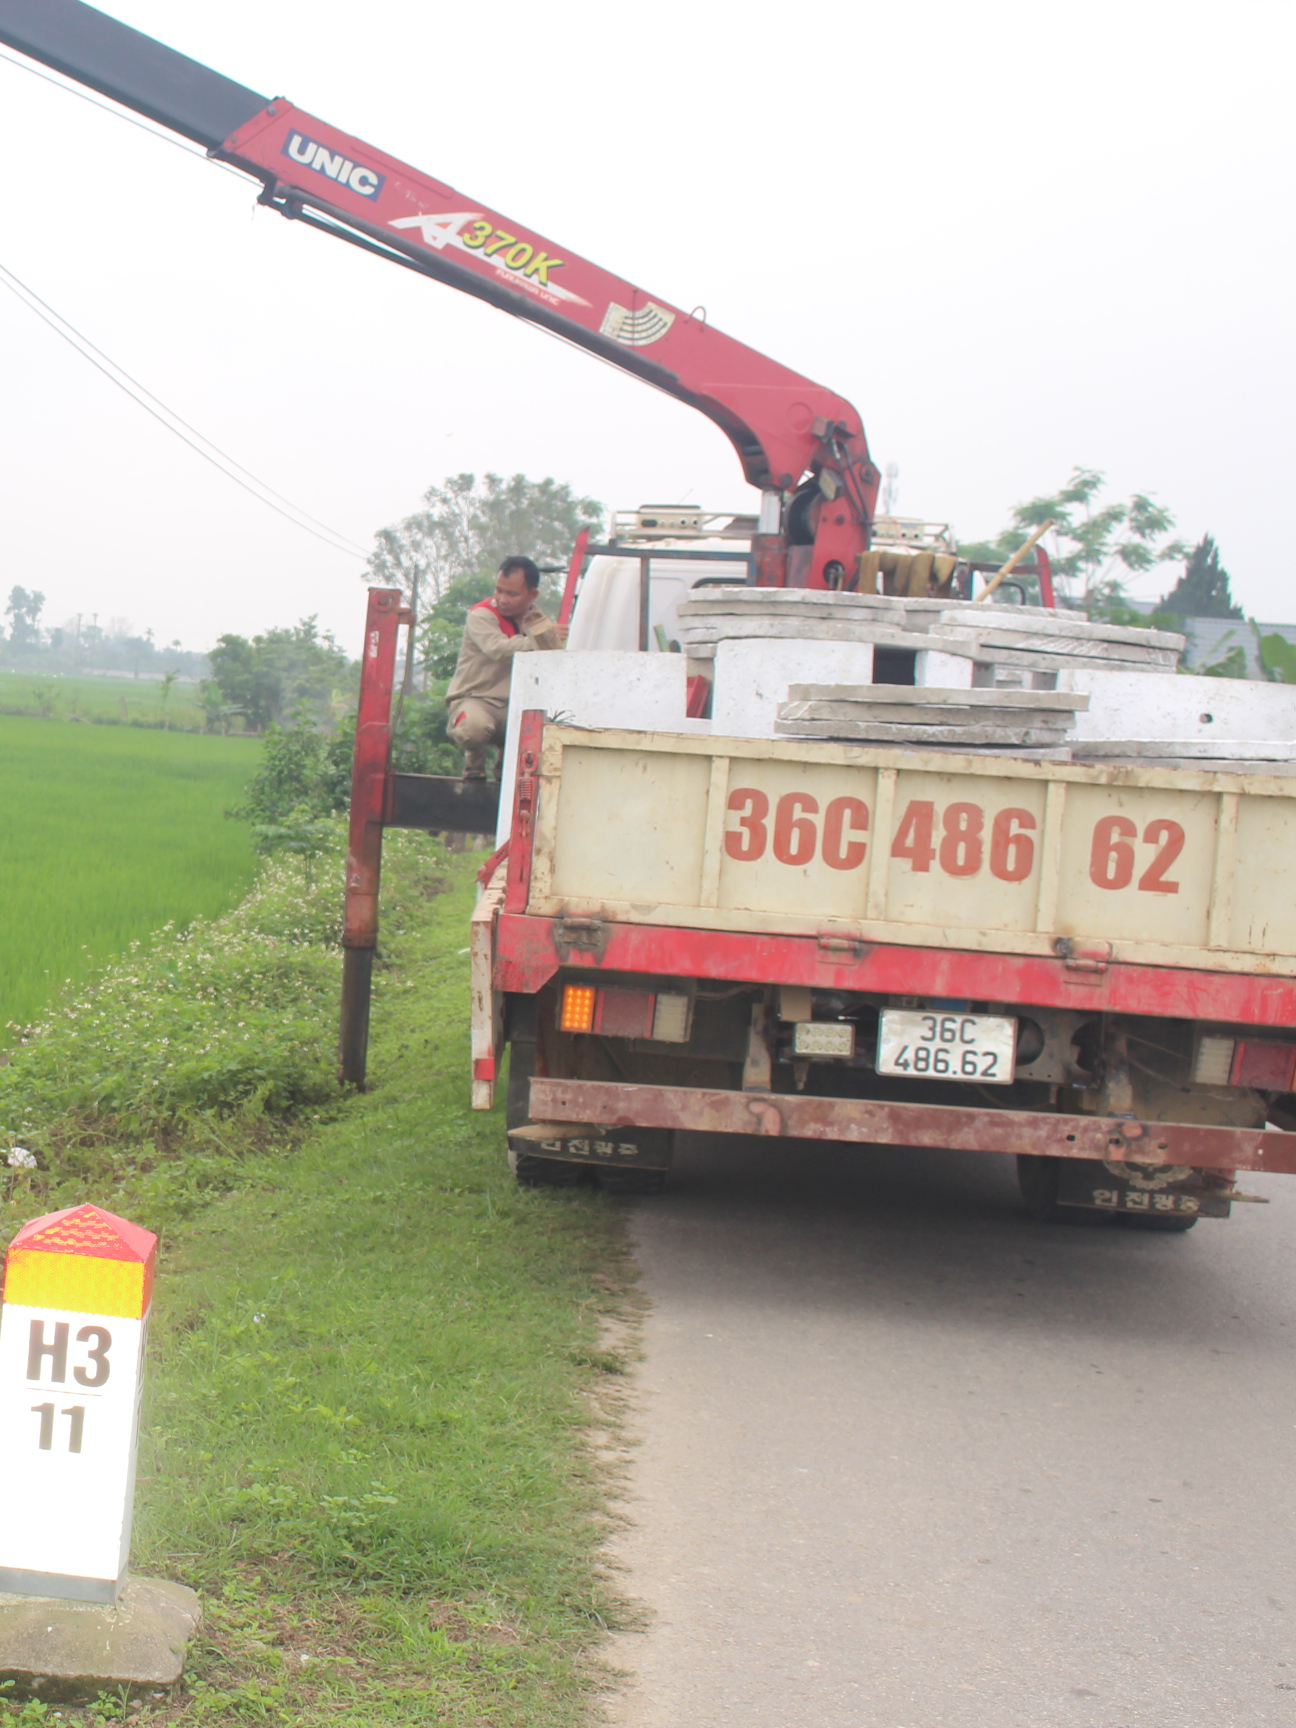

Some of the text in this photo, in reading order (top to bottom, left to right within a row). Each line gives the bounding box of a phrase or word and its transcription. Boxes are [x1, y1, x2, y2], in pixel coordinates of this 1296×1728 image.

[287, 133, 380, 198] UNIC
[462, 220, 566, 287] 370K
[724, 787, 1186, 895] 36C 486 62
[894, 1045, 998, 1078] 486.62
[920, 1015, 977, 1044] 36C
[25, 1319, 113, 1388] H3
[30, 1402, 86, 1454] 11
